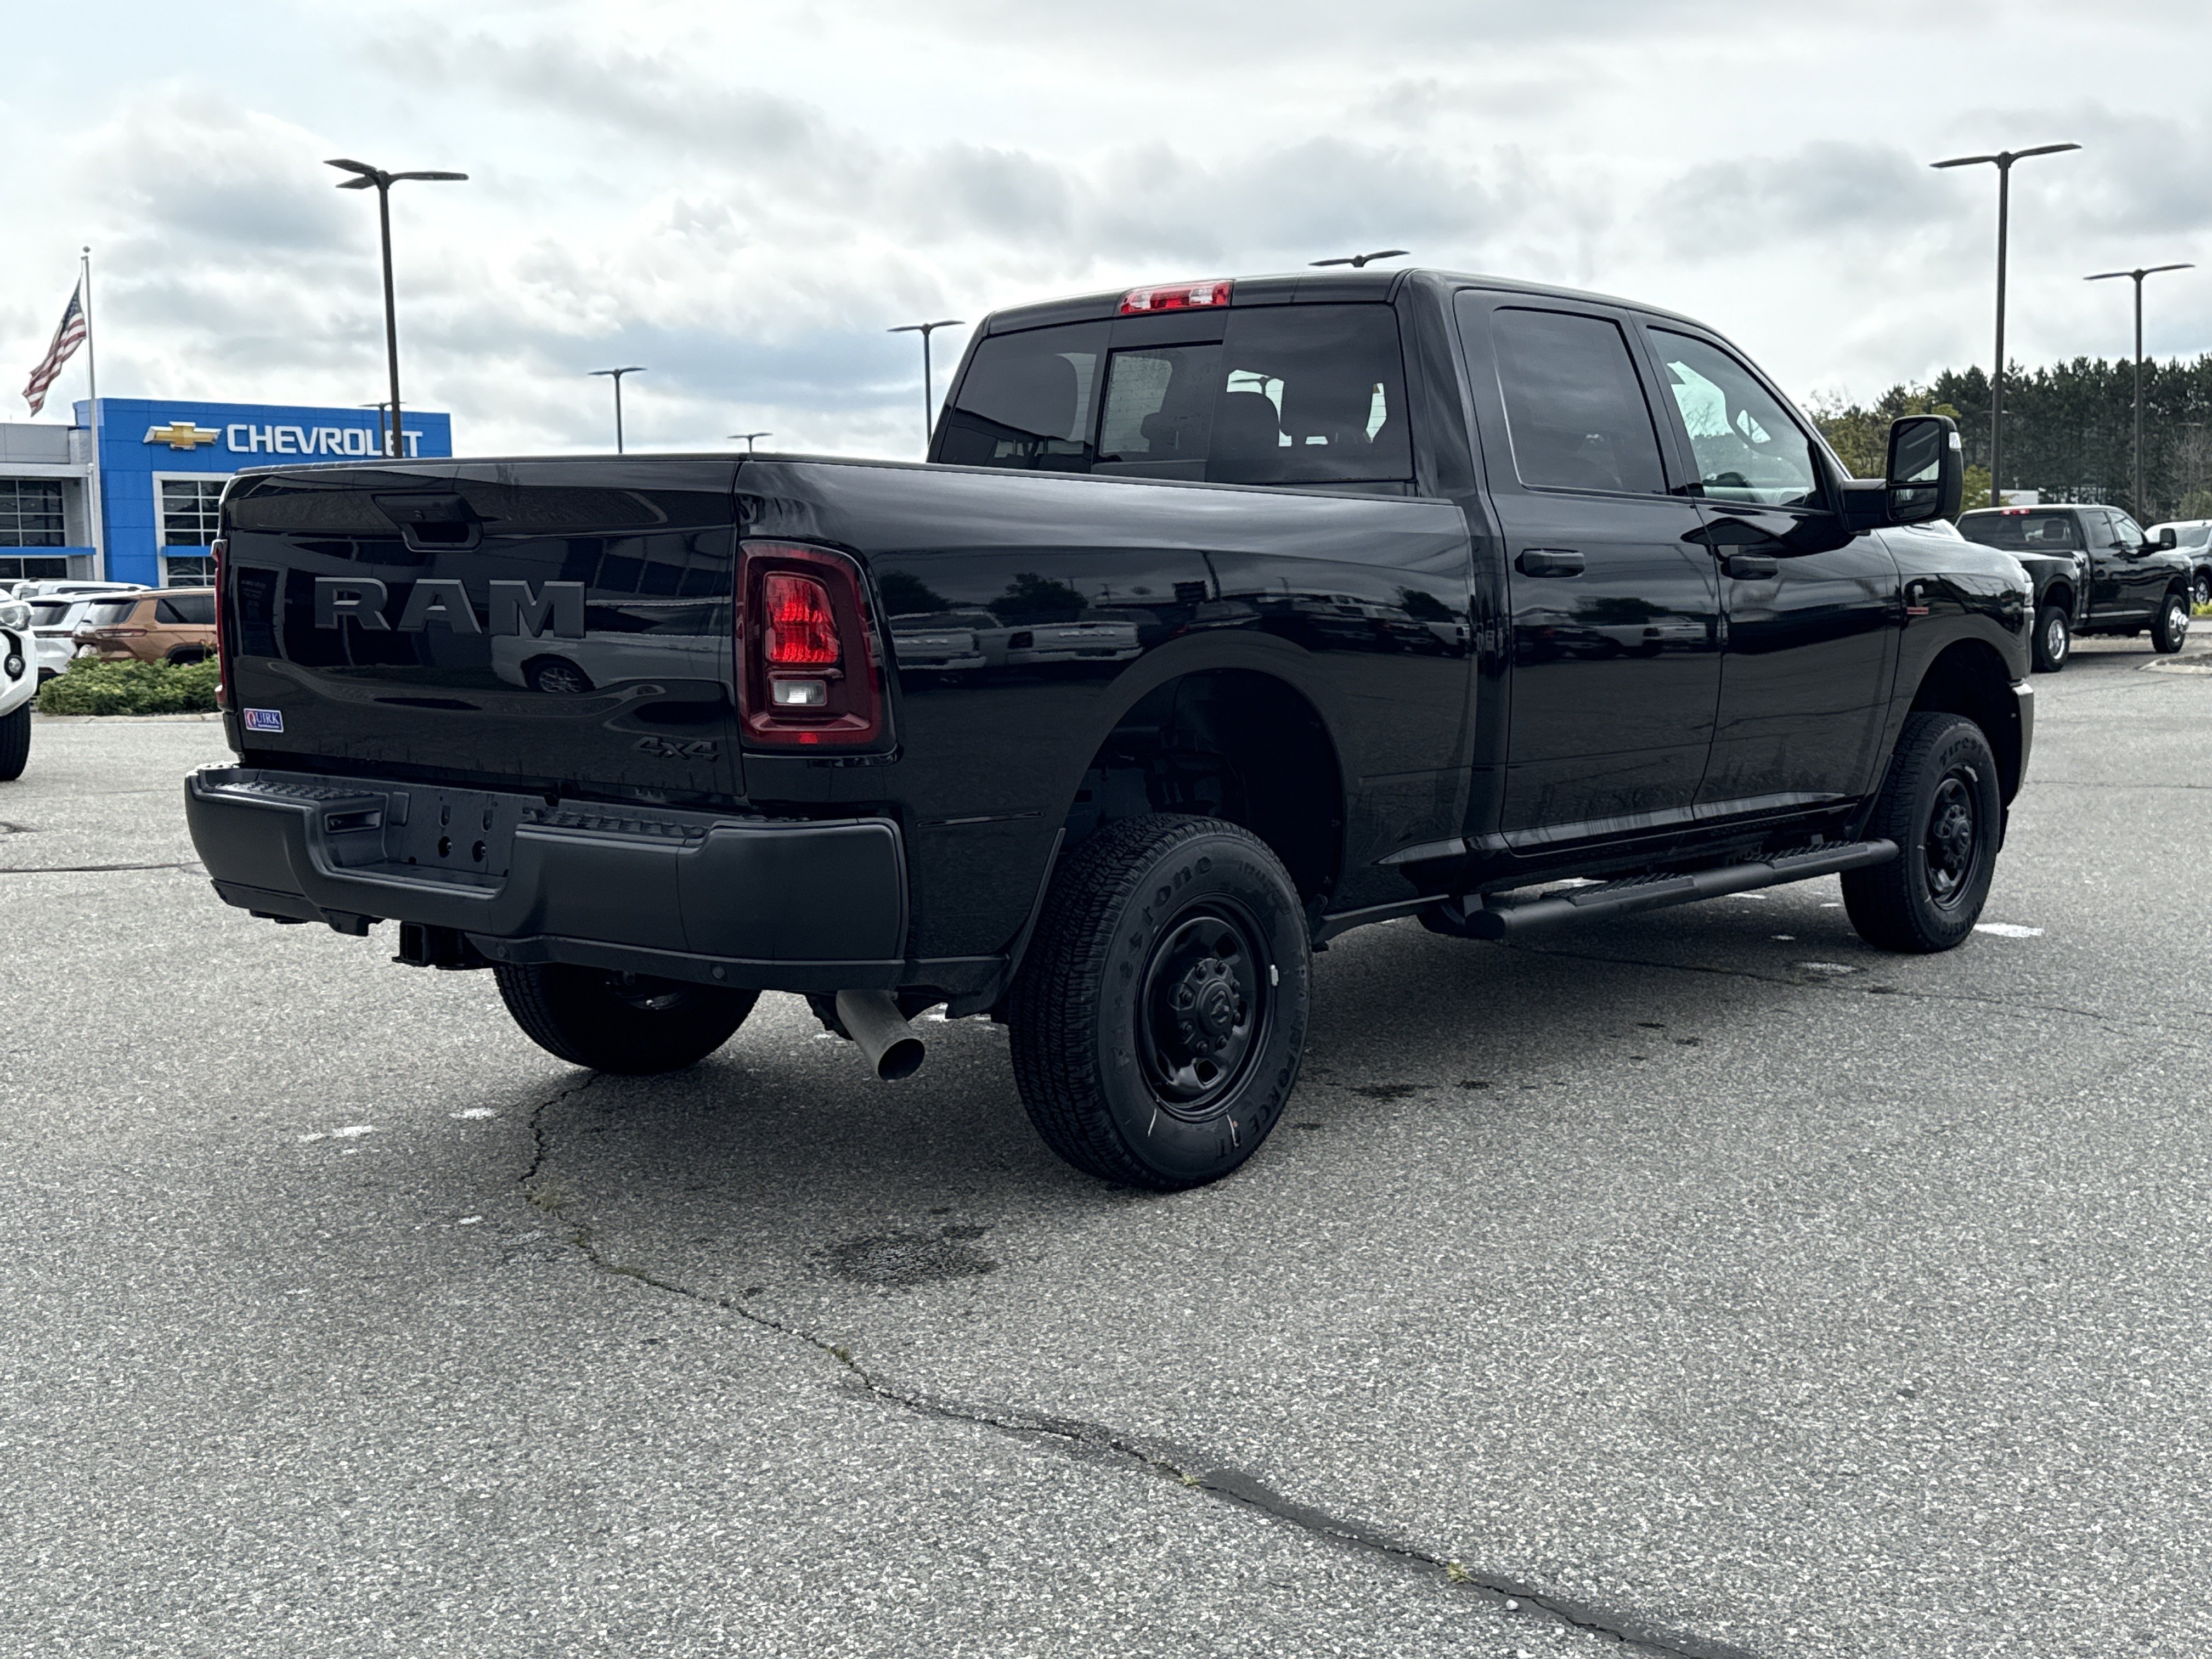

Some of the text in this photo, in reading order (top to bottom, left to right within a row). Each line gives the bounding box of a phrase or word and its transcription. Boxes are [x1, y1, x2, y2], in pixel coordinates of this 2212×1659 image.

[227, 424, 423, 458] CHEVROLET
[315, 577, 585, 639] RAM
[247, 711, 280, 727] QUIRK
